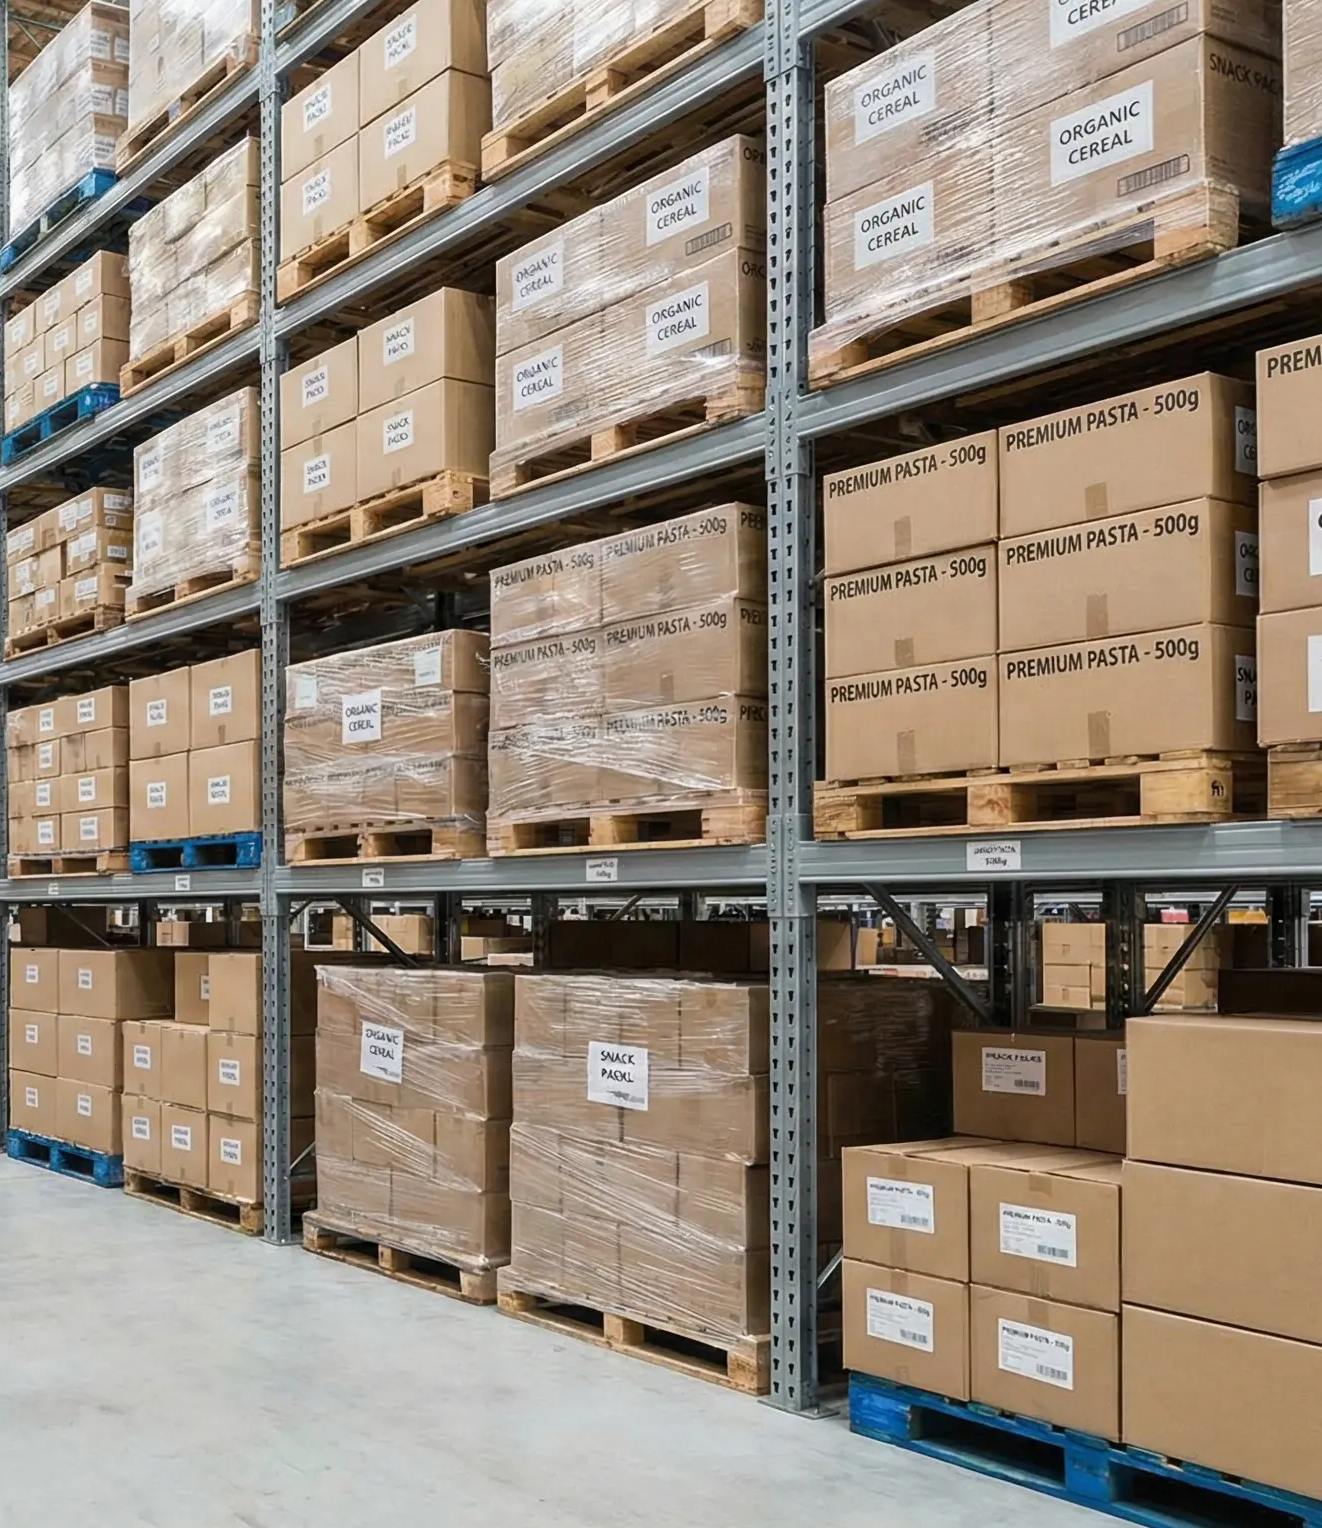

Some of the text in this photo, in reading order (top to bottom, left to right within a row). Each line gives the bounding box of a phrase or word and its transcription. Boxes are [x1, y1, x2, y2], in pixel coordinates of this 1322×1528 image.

[1068, 0, 1116, 24] CERE
[861, 64, 927, 107] ORGANIC
[1210, 53, 1251, 88] SNACK
[868, 92, 920, 125] CEREAL
[1059, 100, 1140, 146] ORGANIC
[1069, 129, 1133, 165] CEREAL
[652, 181, 702, 214] ORGANIC
[861, 195, 925, 234] ORGANIC
[657, 203, 697, 229] CEREAL
[867, 224, 919, 251] CEREAL
[652, 295, 702, 324] ORGANIC
[658, 316, 697, 340] CEREAL
[1007, 416, 1081, 451] PREMIUM
[1087, 401, 1138, 431] PASTA
[1154, 389, 1199, 415] 500g
[830, 467, 891, 498] PREMIUM
[895, 456, 938, 481] PASTA
[1007, 533, 1081, 566] PREMIUM
[1087, 523, 1138, 549] PASTA
[1153, 512, 1199, 537] 500g
[831, 573, 892, 601] PREMIUM
[895, 564, 938, 589] PASTA
[658, 617, 690, 636] PASTA
[699, 612, 726, 628] 500g
[1007, 652, 1082, 680] PREMIUM
[1088, 644, 1139, 669] PASTA
[1154, 637, 1199, 661] 500g
[831, 679, 893, 704] PREMIUM
[896, 672, 938, 694] PASTA
[951, 667, 987, 689] 500g
[601, 1051, 635, 1065] SNACK
